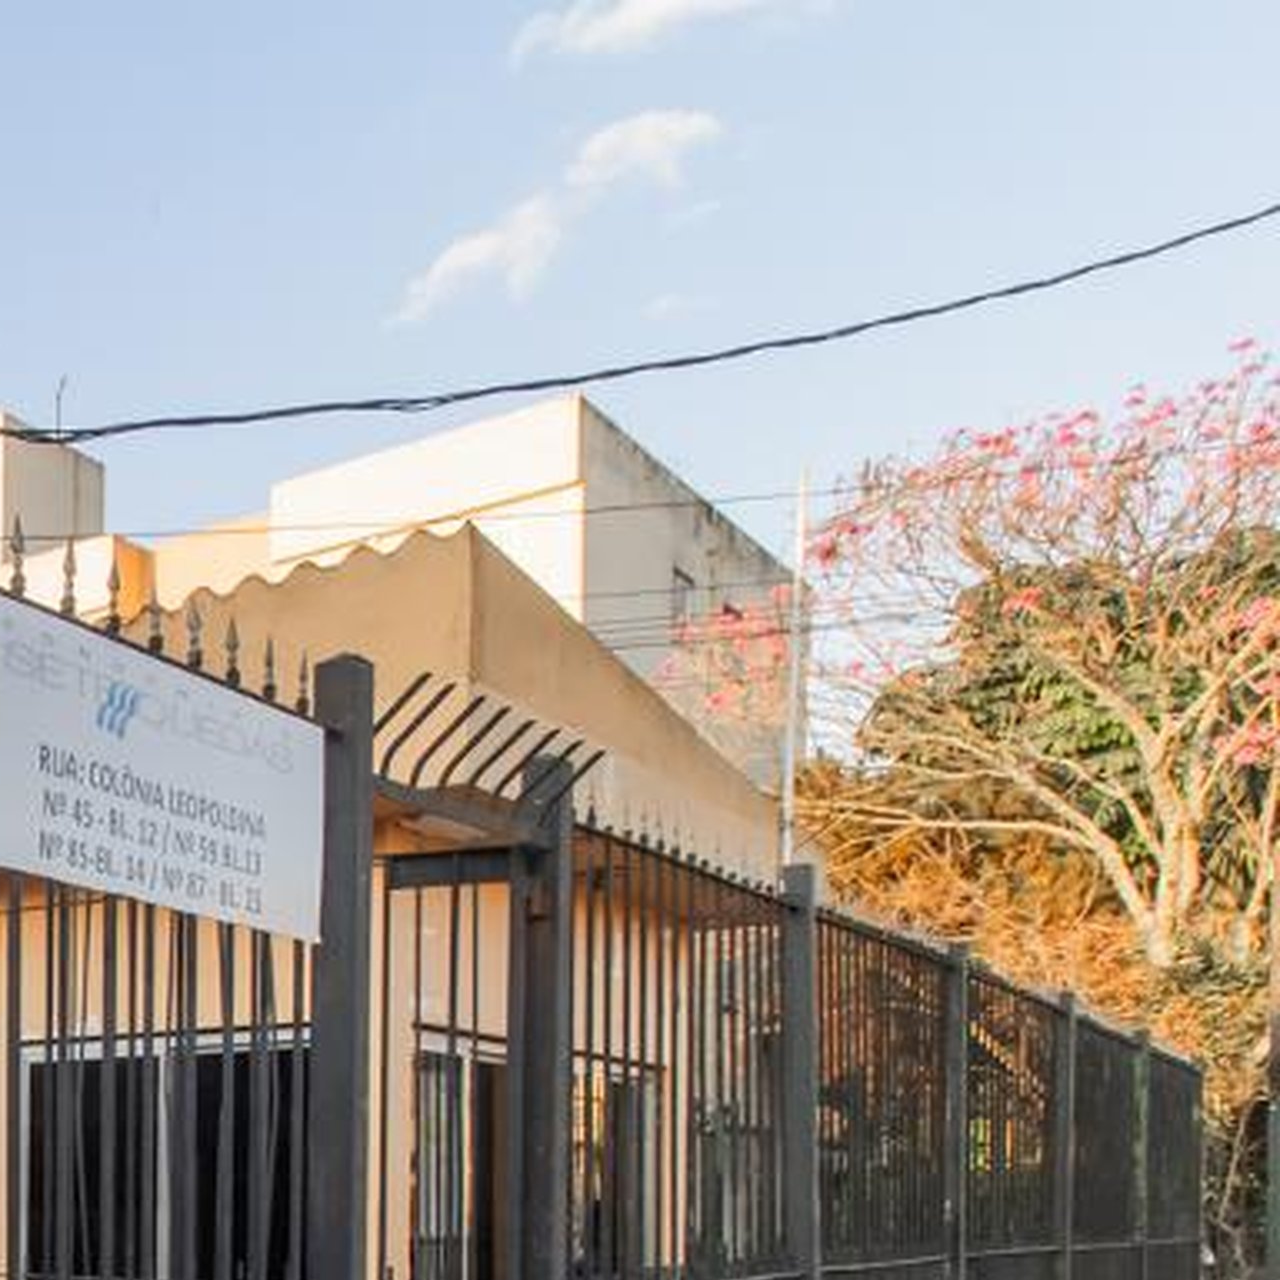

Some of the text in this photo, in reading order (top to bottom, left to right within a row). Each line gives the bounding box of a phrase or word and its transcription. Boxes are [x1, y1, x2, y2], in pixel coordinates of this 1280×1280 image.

[38, 745, 266, 838] RUA: COLÔNIA LEOPOLDINA
[73, 798, 94, 829] 45
